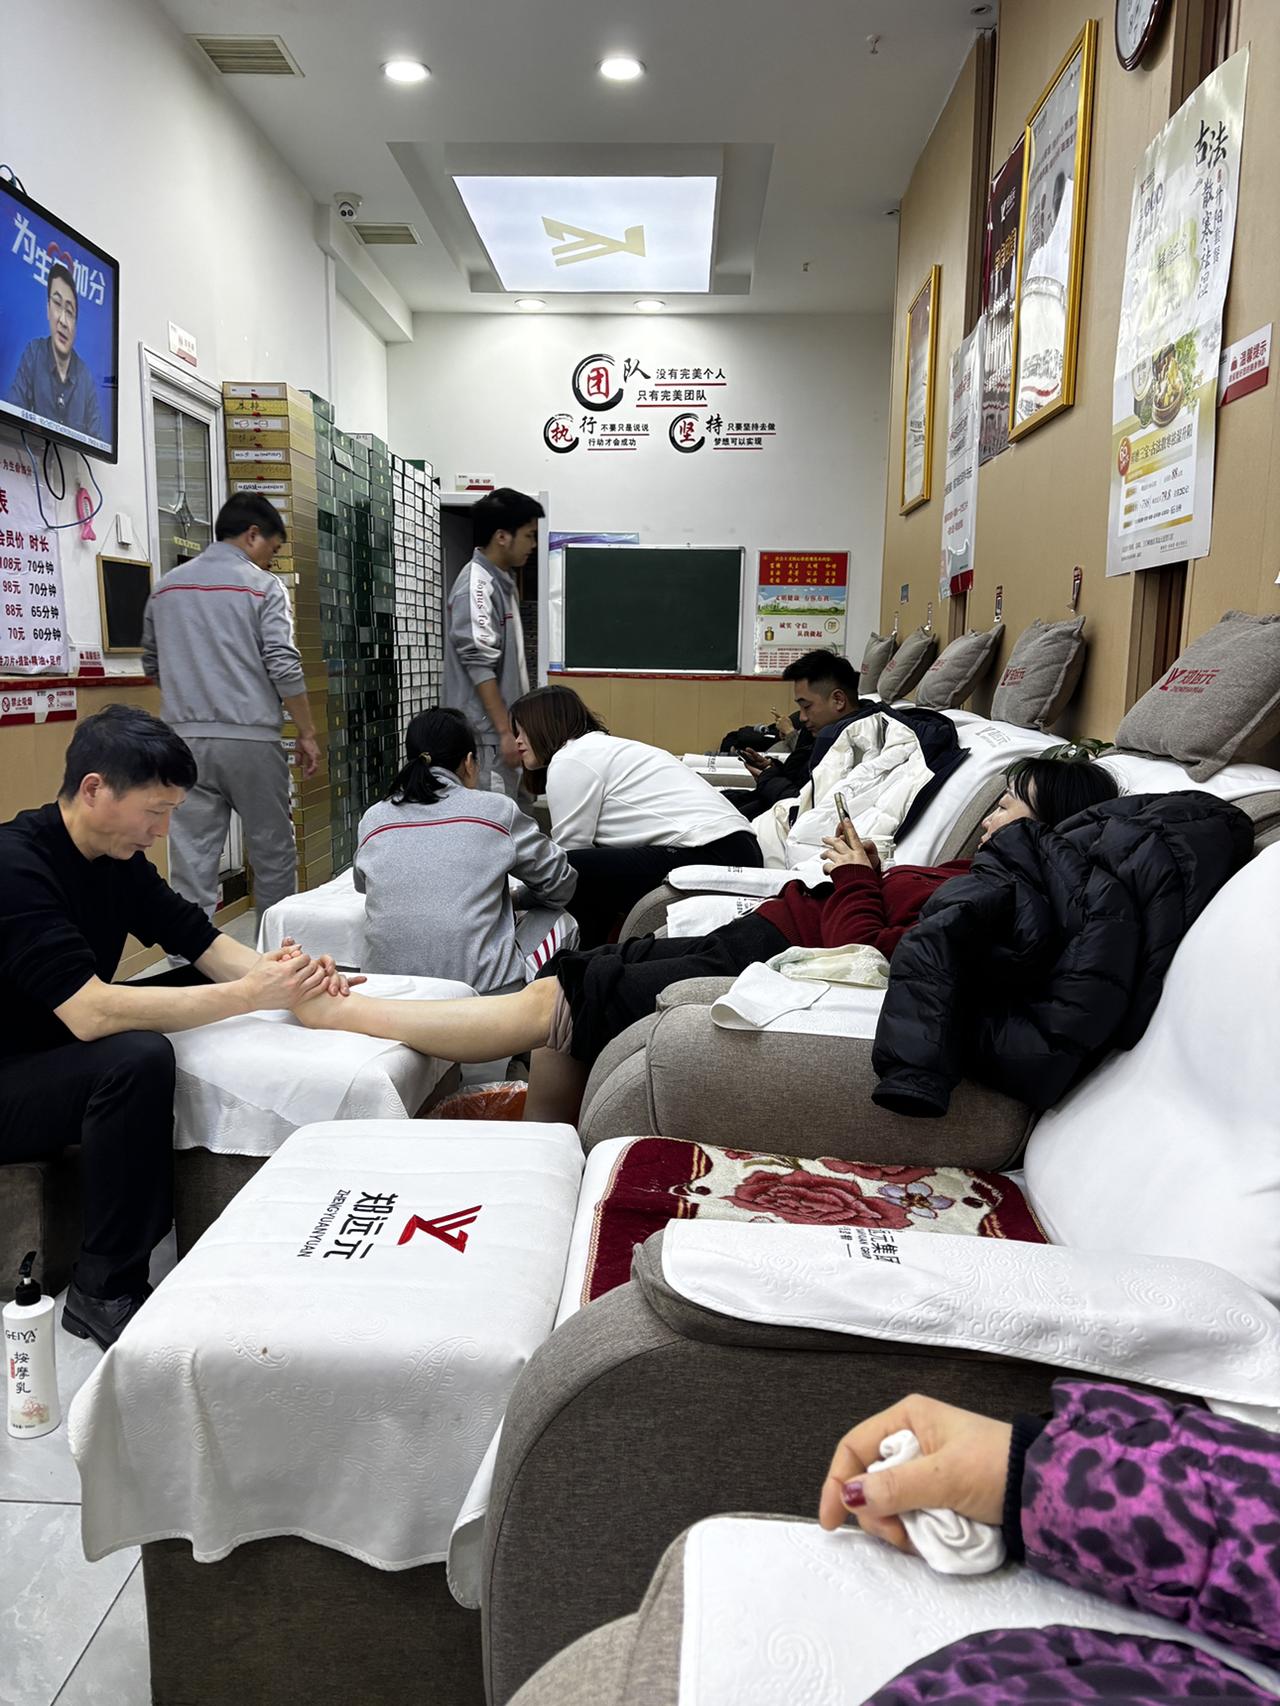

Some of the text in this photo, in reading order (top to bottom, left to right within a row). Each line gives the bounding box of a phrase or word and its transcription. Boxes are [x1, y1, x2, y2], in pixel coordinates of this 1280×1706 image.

[11, 212, 105, 305] 为生加分
[587, 357, 726, 399] 团队 没有完美个人
[637, 390, 708, 401] 只有完美团队
[551, 415, 649, 443] 执行 不要只是说说
[679, 413, 776, 443] 坚持 只要坚持去做
[588, 439, 636, 447] 行动才会成功
[714, 437, 763, 446] 梦想可以实现
[29, 535, 49, 553] 时长
[28, 560, 54, 575] 70分钟
[3, 580, 56, 597] 98元 70分钟
[5, 604, 59, 620] 88元 65分钟
[8, 627, 62, 642] 70元 60分钟
[297, 1189, 351, 1258] ZHENGYUANYUAN
[323, 1191, 398, 1259] 郑远元
[14, 1351, 31, 1394] 按摩乳
